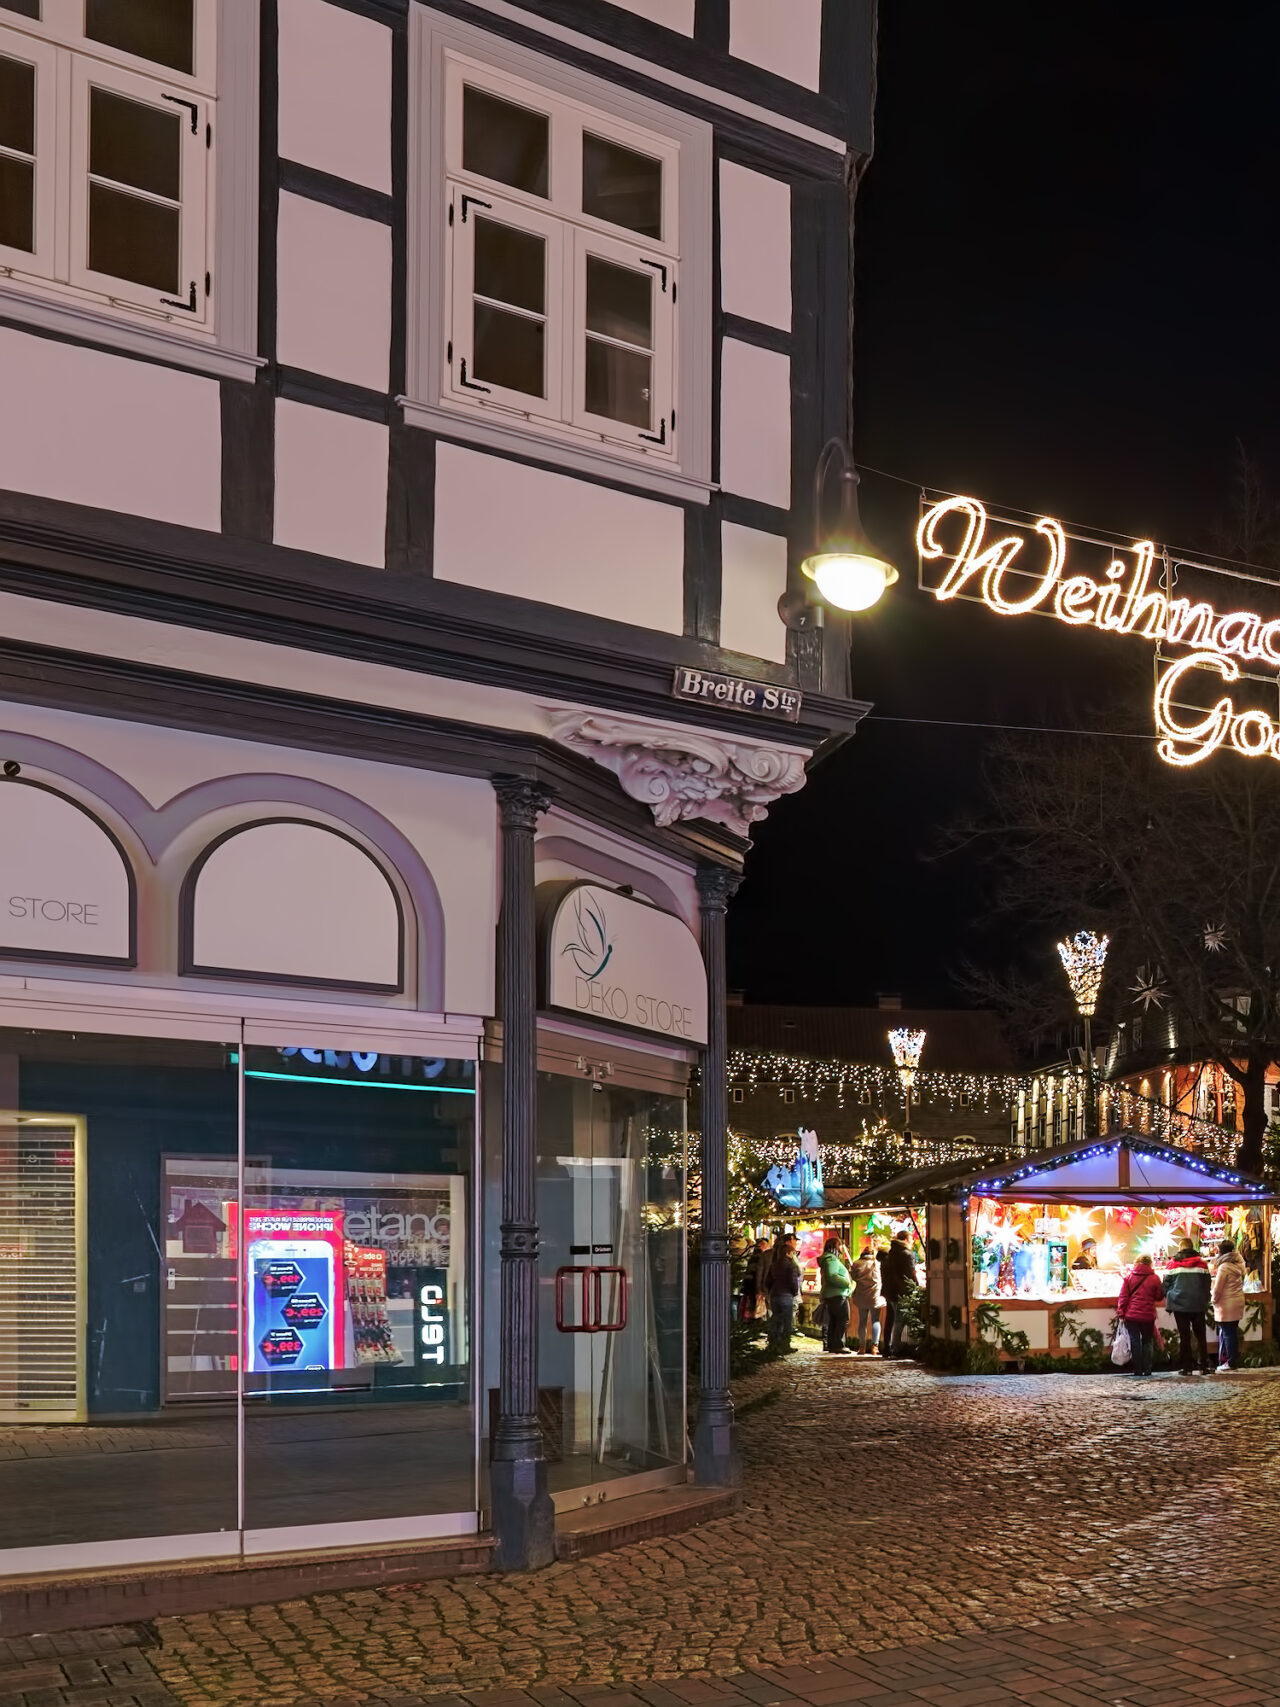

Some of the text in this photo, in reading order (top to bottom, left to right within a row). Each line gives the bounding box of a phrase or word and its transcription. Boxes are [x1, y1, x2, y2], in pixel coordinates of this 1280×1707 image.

[681, 670, 756, 705] Breite
[8, 896, 98, 925] STORE
[575, 975, 692, 1037] DEKO STORE
